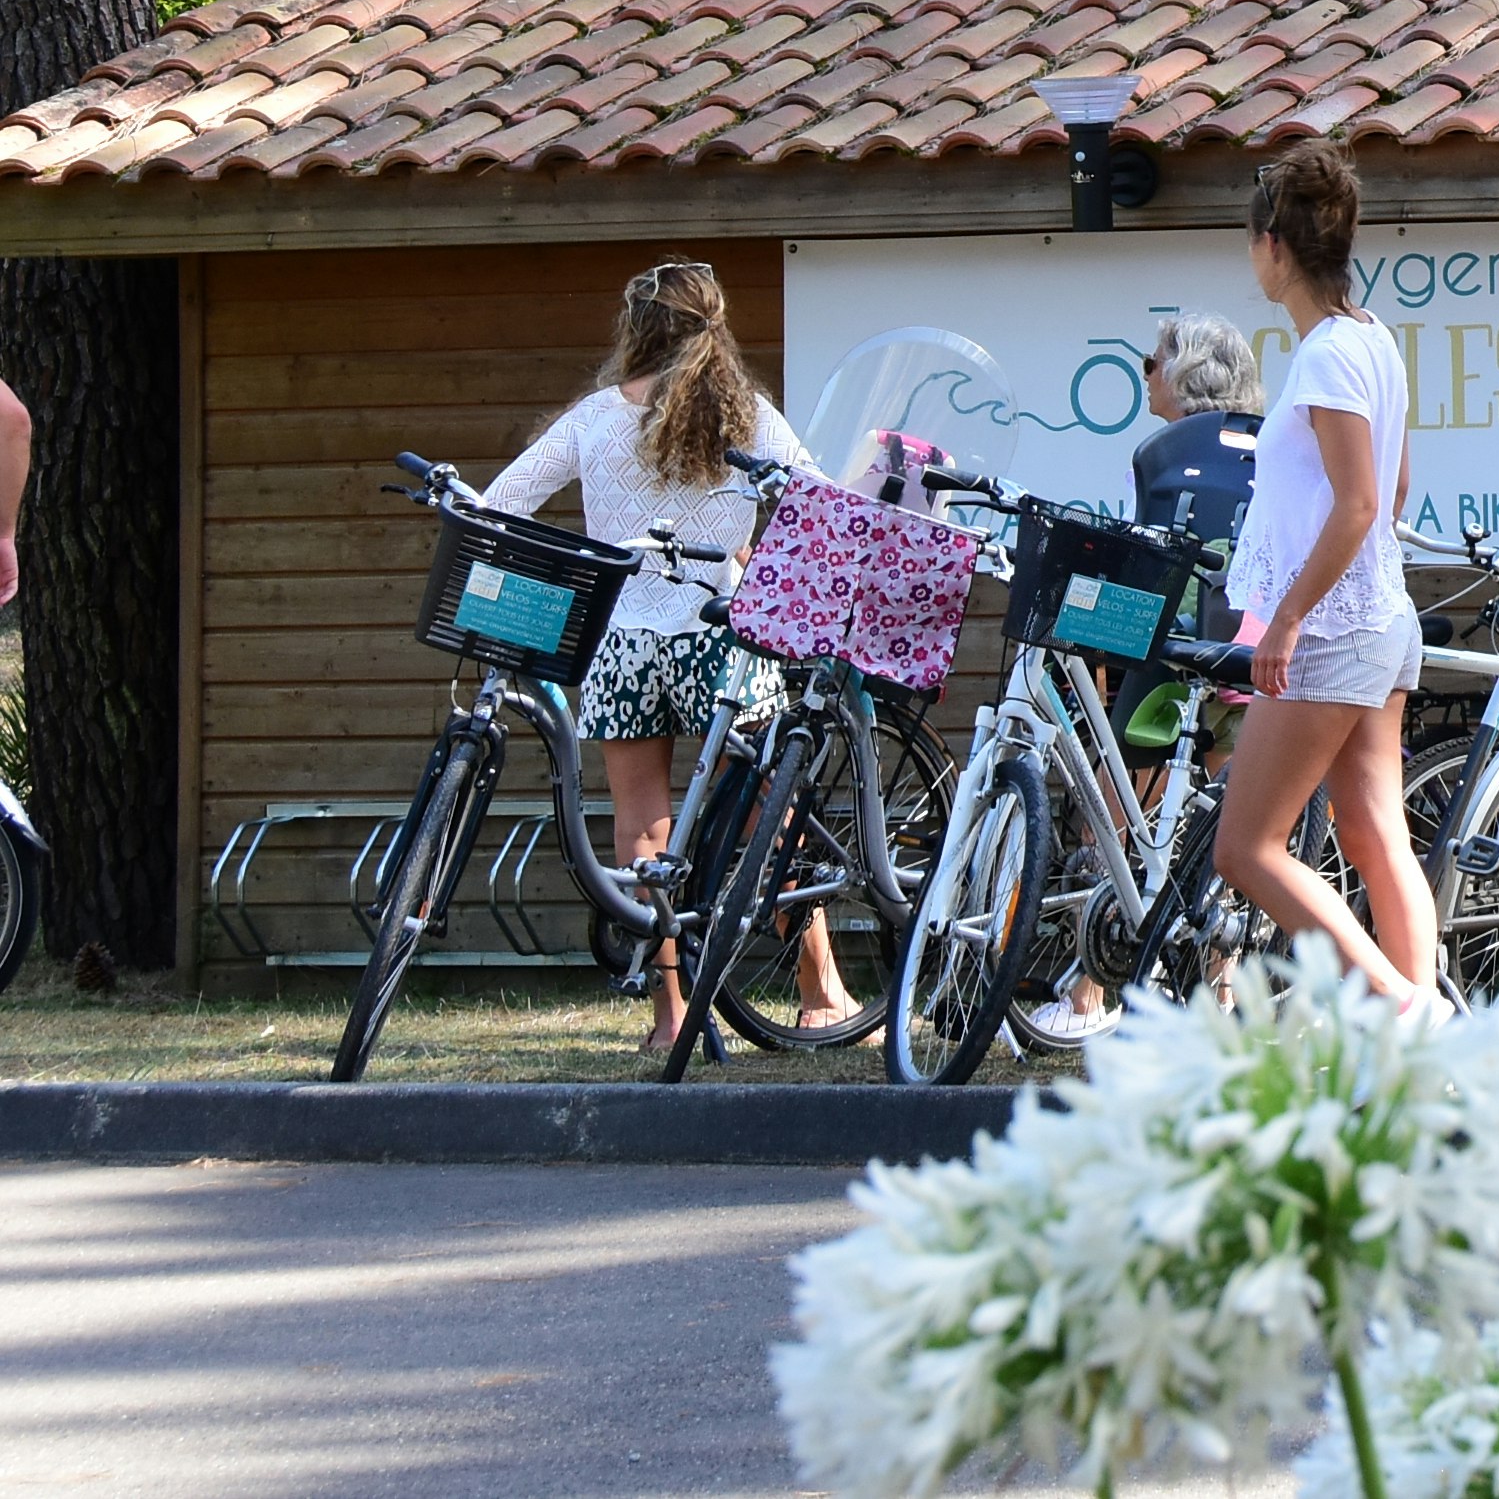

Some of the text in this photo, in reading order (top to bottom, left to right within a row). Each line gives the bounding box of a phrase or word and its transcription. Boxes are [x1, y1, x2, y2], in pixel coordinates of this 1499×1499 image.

[1414, 492, 1443, 533] A
[514, 580, 565, 601] LOCATION
[1110, 589, 1156, 606] LOCATION
